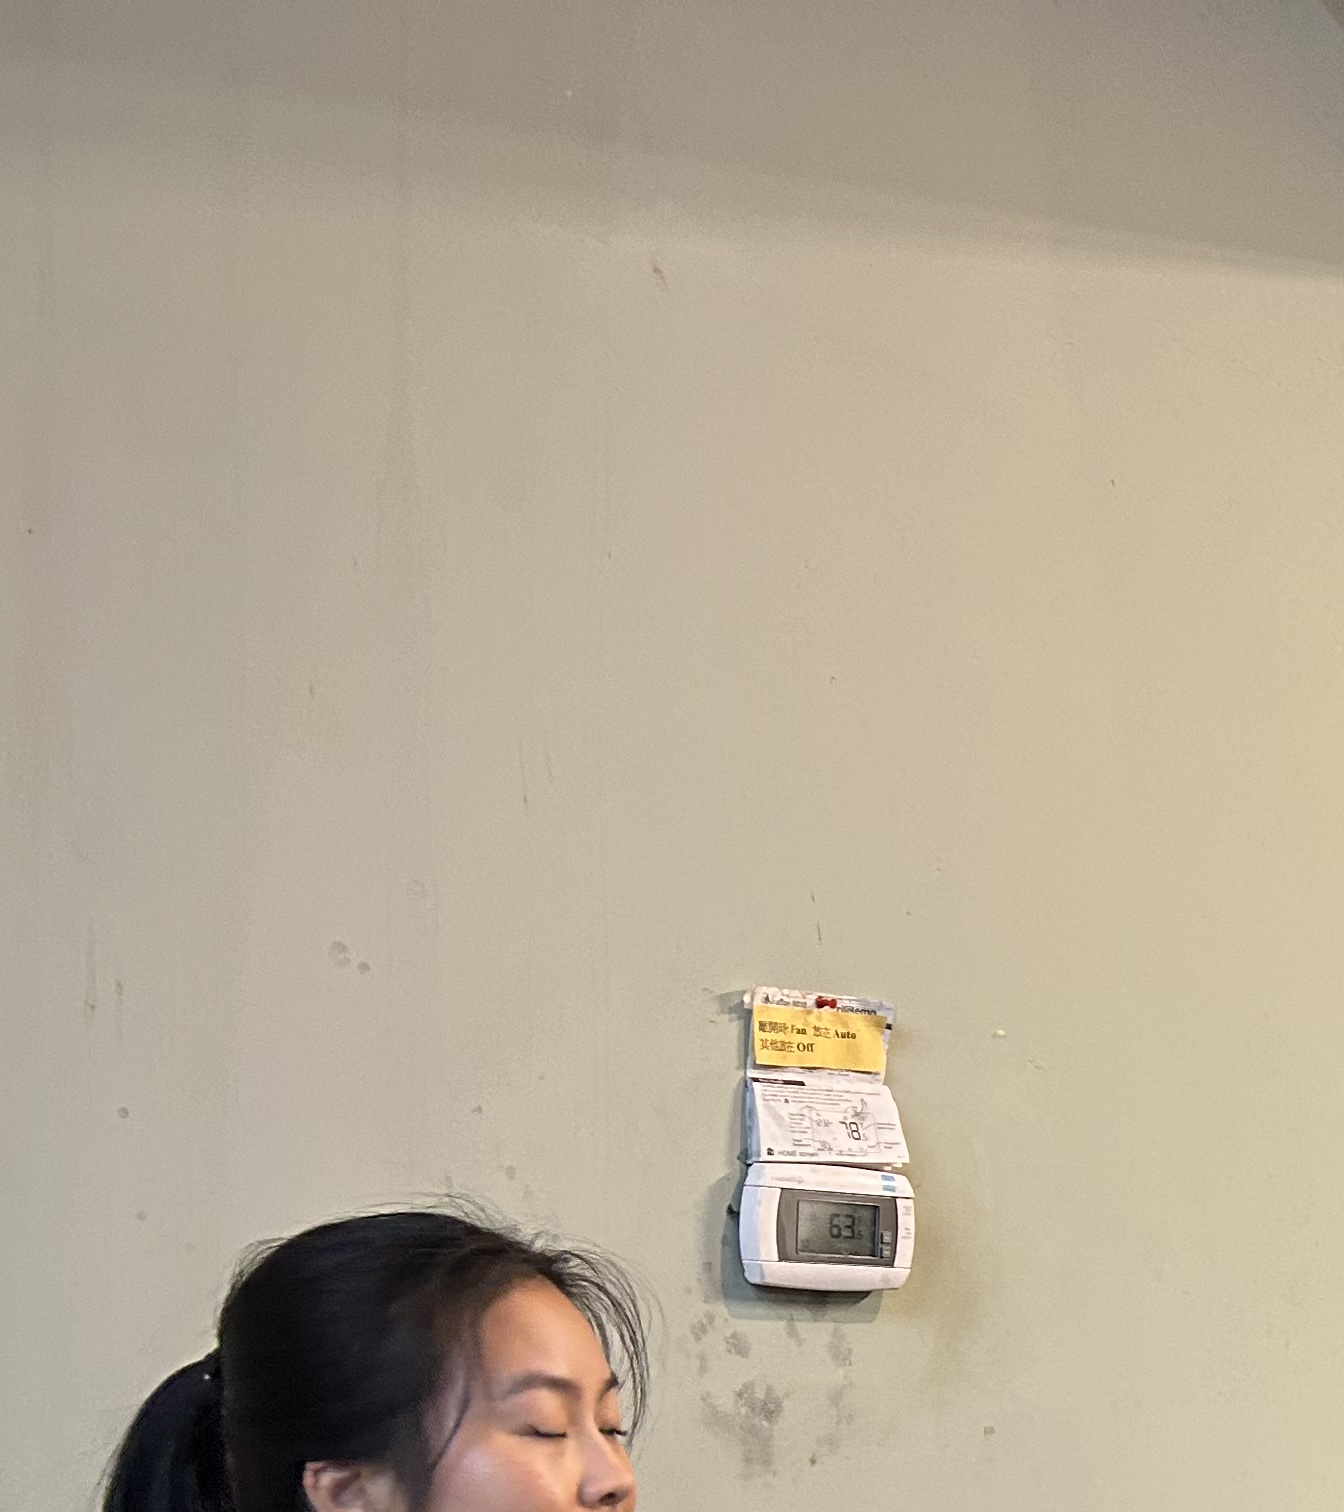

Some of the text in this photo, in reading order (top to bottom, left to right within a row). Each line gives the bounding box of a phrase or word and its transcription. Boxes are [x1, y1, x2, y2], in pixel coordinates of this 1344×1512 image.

[790, 1025, 807, 1035] Fan
[833, 1029, 857, 1040] Auto
[797, 1043, 816, 1053] Off
